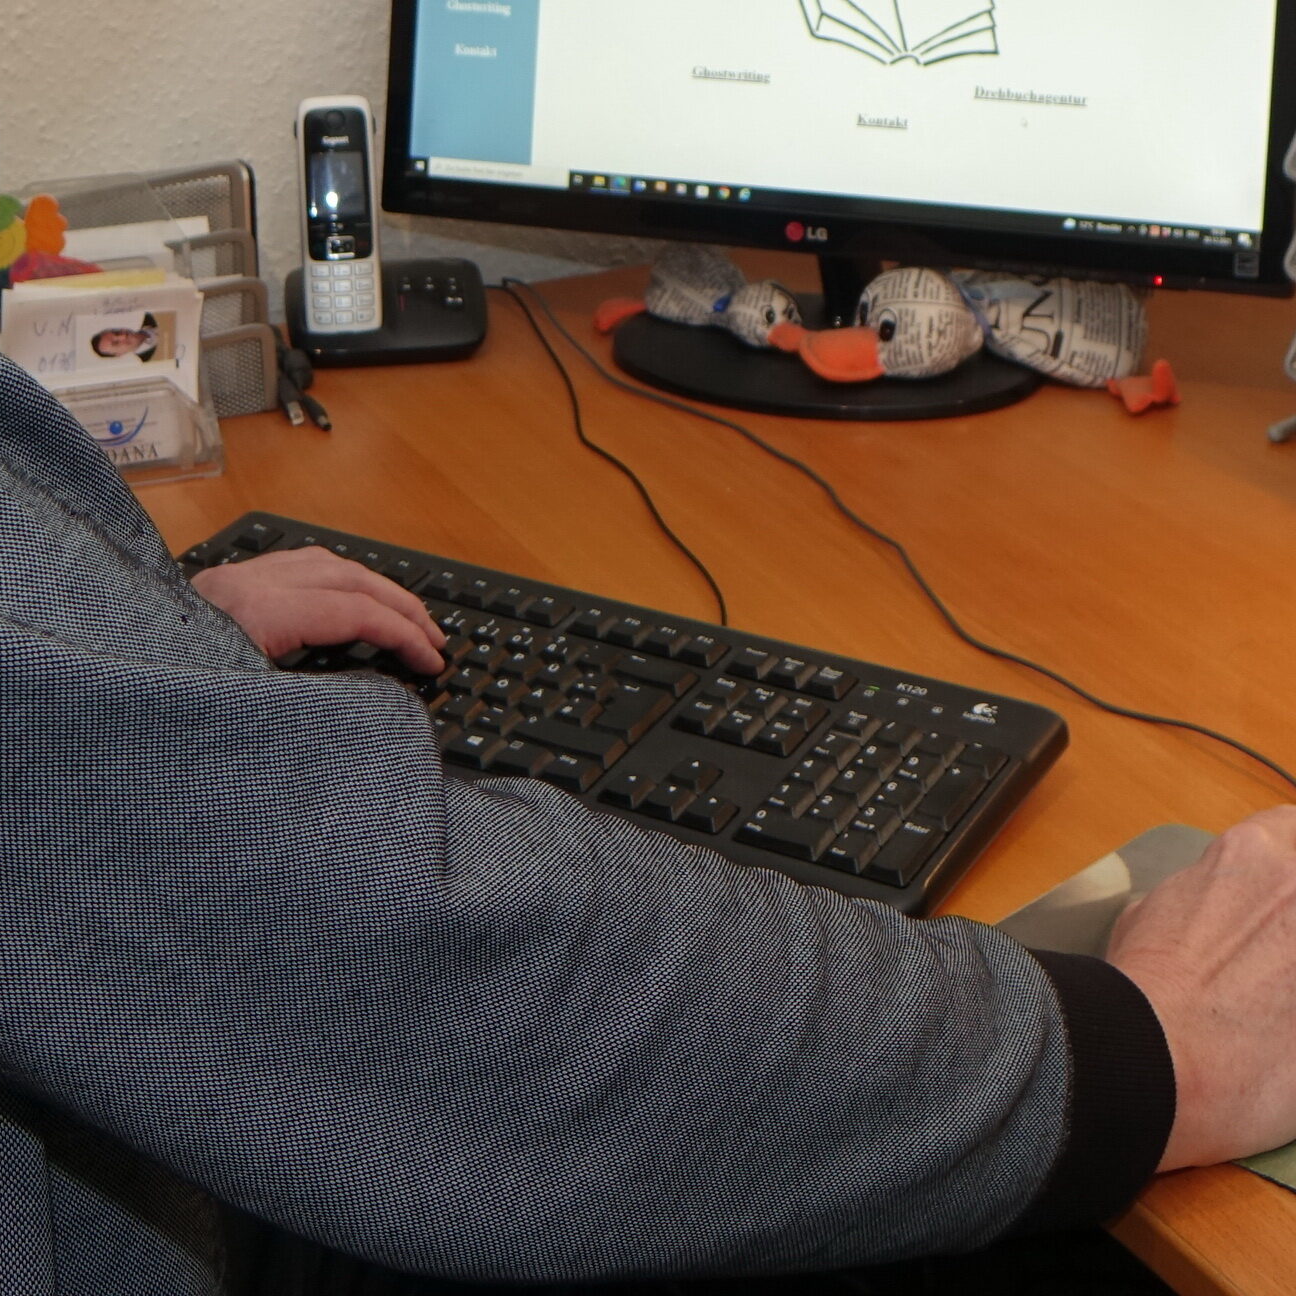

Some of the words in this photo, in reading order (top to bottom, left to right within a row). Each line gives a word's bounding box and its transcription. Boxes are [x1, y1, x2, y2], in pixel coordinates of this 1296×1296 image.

[691, 65, 771, 84] Ghostwriting
[974, 84, 1088, 106] Drehbuchagentur
[856, 112, 908, 129] Kontakt
[807, 225, 829, 241] LG
[896, 682, 929, 697] K120
[904, 821, 931, 834] Enter
